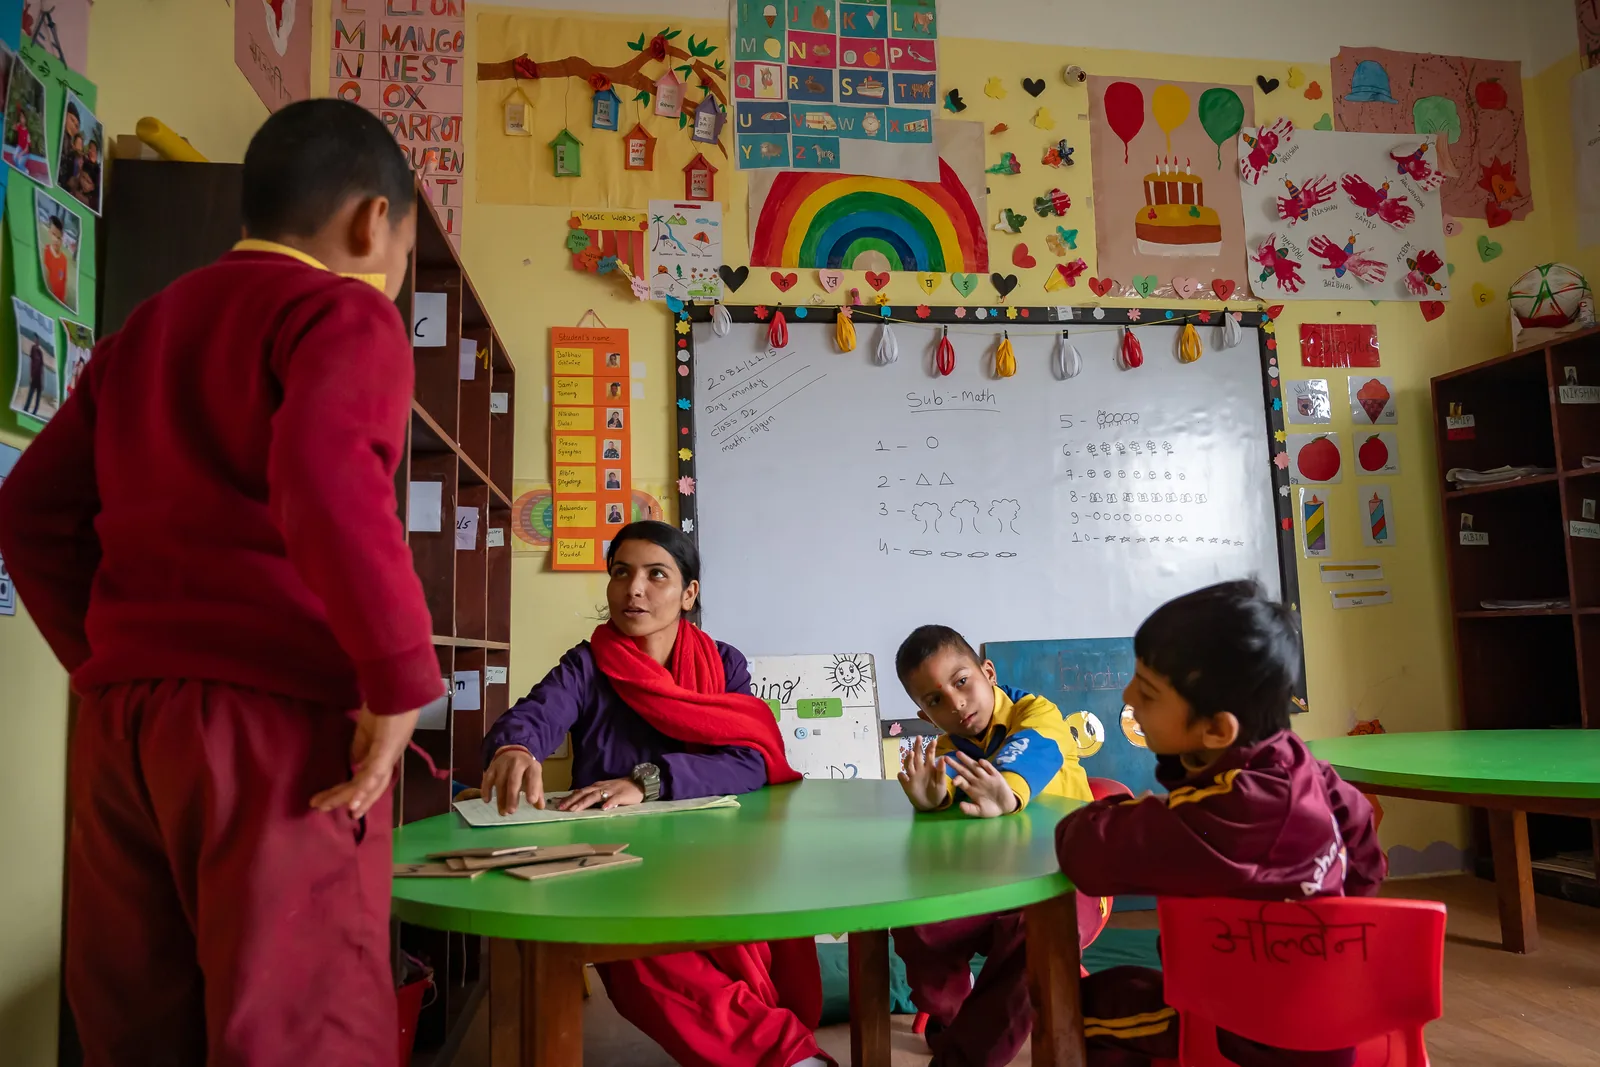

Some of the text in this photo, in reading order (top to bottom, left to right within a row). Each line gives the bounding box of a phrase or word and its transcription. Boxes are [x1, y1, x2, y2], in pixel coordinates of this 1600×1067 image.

[792, 6, 799, 23] J
[843, 13, 857, 30] K
[893, 12, 902, 32] L
[335, 19, 464, 53] M MANGO
[740, 38, 902, 65] M N O P
[336, 53, 458, 83] N NEST
[736, 74, 907, 98] Q R S T
[383, 84, 427, 109] OX
[381, 112, 463, 142] PARROT
[740, 113, 900, 133] U V W X
[741, 145, 806, 159] Y Z
[582, 213, 636, 222] MAGIC WORDS
[1355, 212, 1377, 230] SAMIP
[780, 278, 790, 288] क
[826, 276, 838, 287] ख
[1098, 284, 1105, 292] A
[1141, 282, 1149, 294] B
[1183, 284, 1190, 293] C
[1220, 284, 1228, 295] D
[558, 333, 590, 341] Student's
[707, 348, 777, 391] 2081/11/5
[1059, 413, 1073, 429] 5
[875, 440, 891, 452] 1
[1062, 443, 1071, 457] 6
[1065, 469, 1074, 480] 7
[877, 475, 891, 489] 2
[1069, 490, 1078, 503] 8
[878, 501, 889, 517] 3
[1071, 511, 1080, 524] 9
[1071, 531, 1091, 543] 10
[1462, 533, 1484, 543] ALBIN
[879, 537, 889, 555] 4
